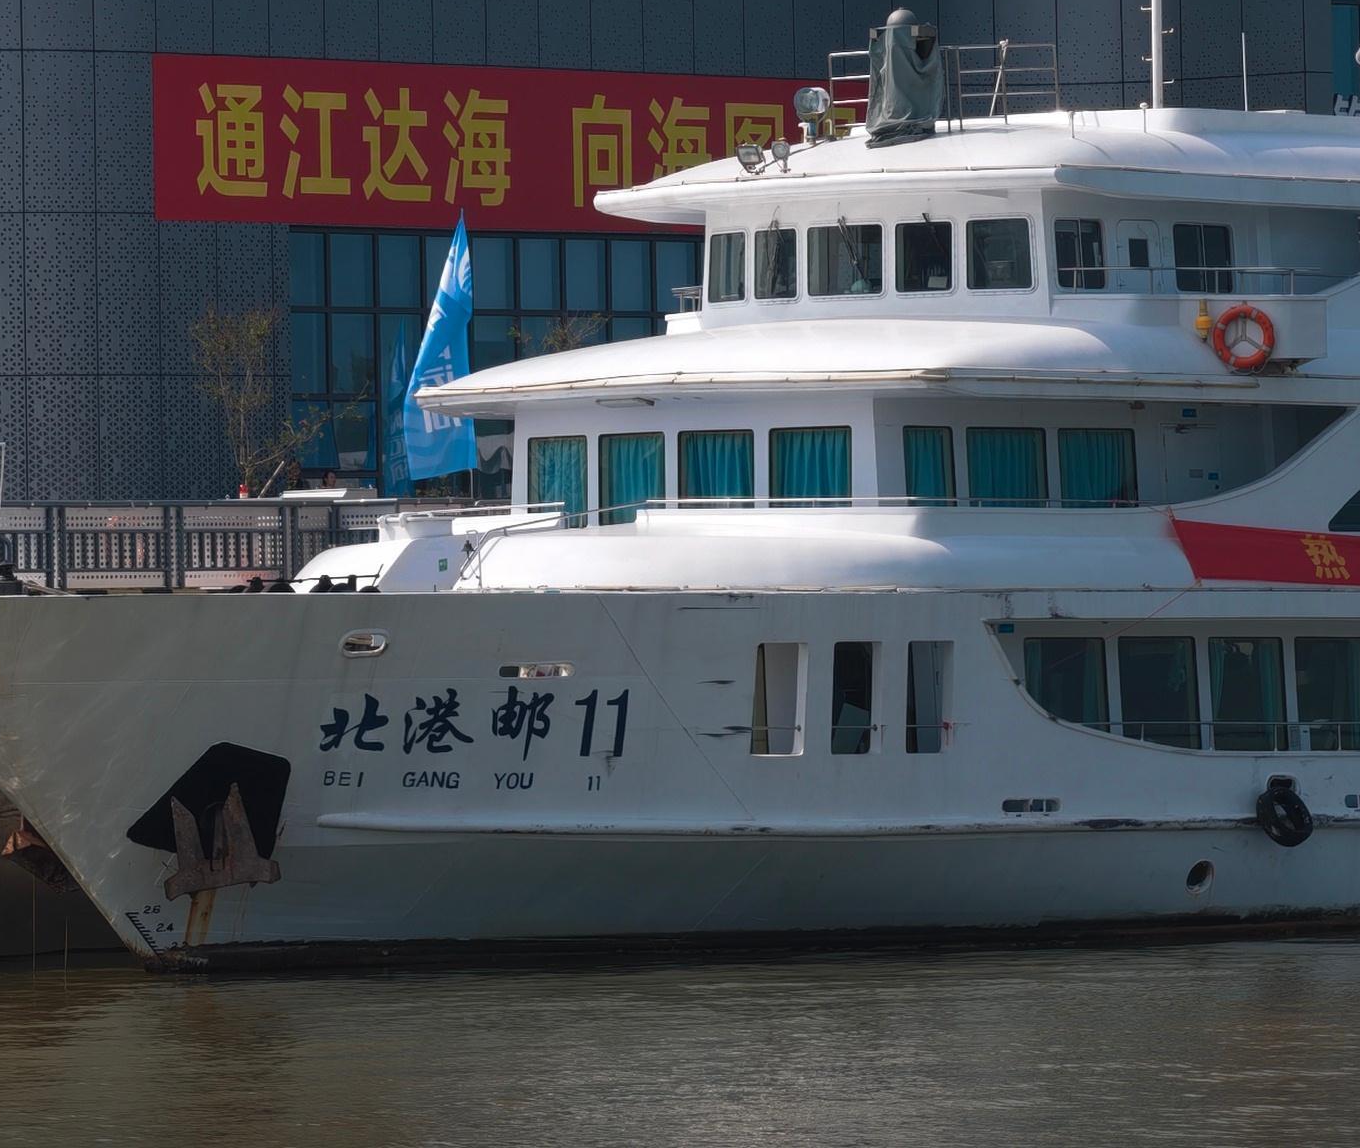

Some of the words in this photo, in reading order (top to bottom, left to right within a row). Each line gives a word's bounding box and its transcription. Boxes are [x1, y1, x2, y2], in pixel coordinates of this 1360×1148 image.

[196, 82, 512, 207] 通江达海
[571, 94, 857, 207] 向海图
[323, 770, 364, 788] BEI
[402, 771, 461, 790] GANG
[494, 772, 534, 790] YOU
[587, 775, 601, 791] 11
